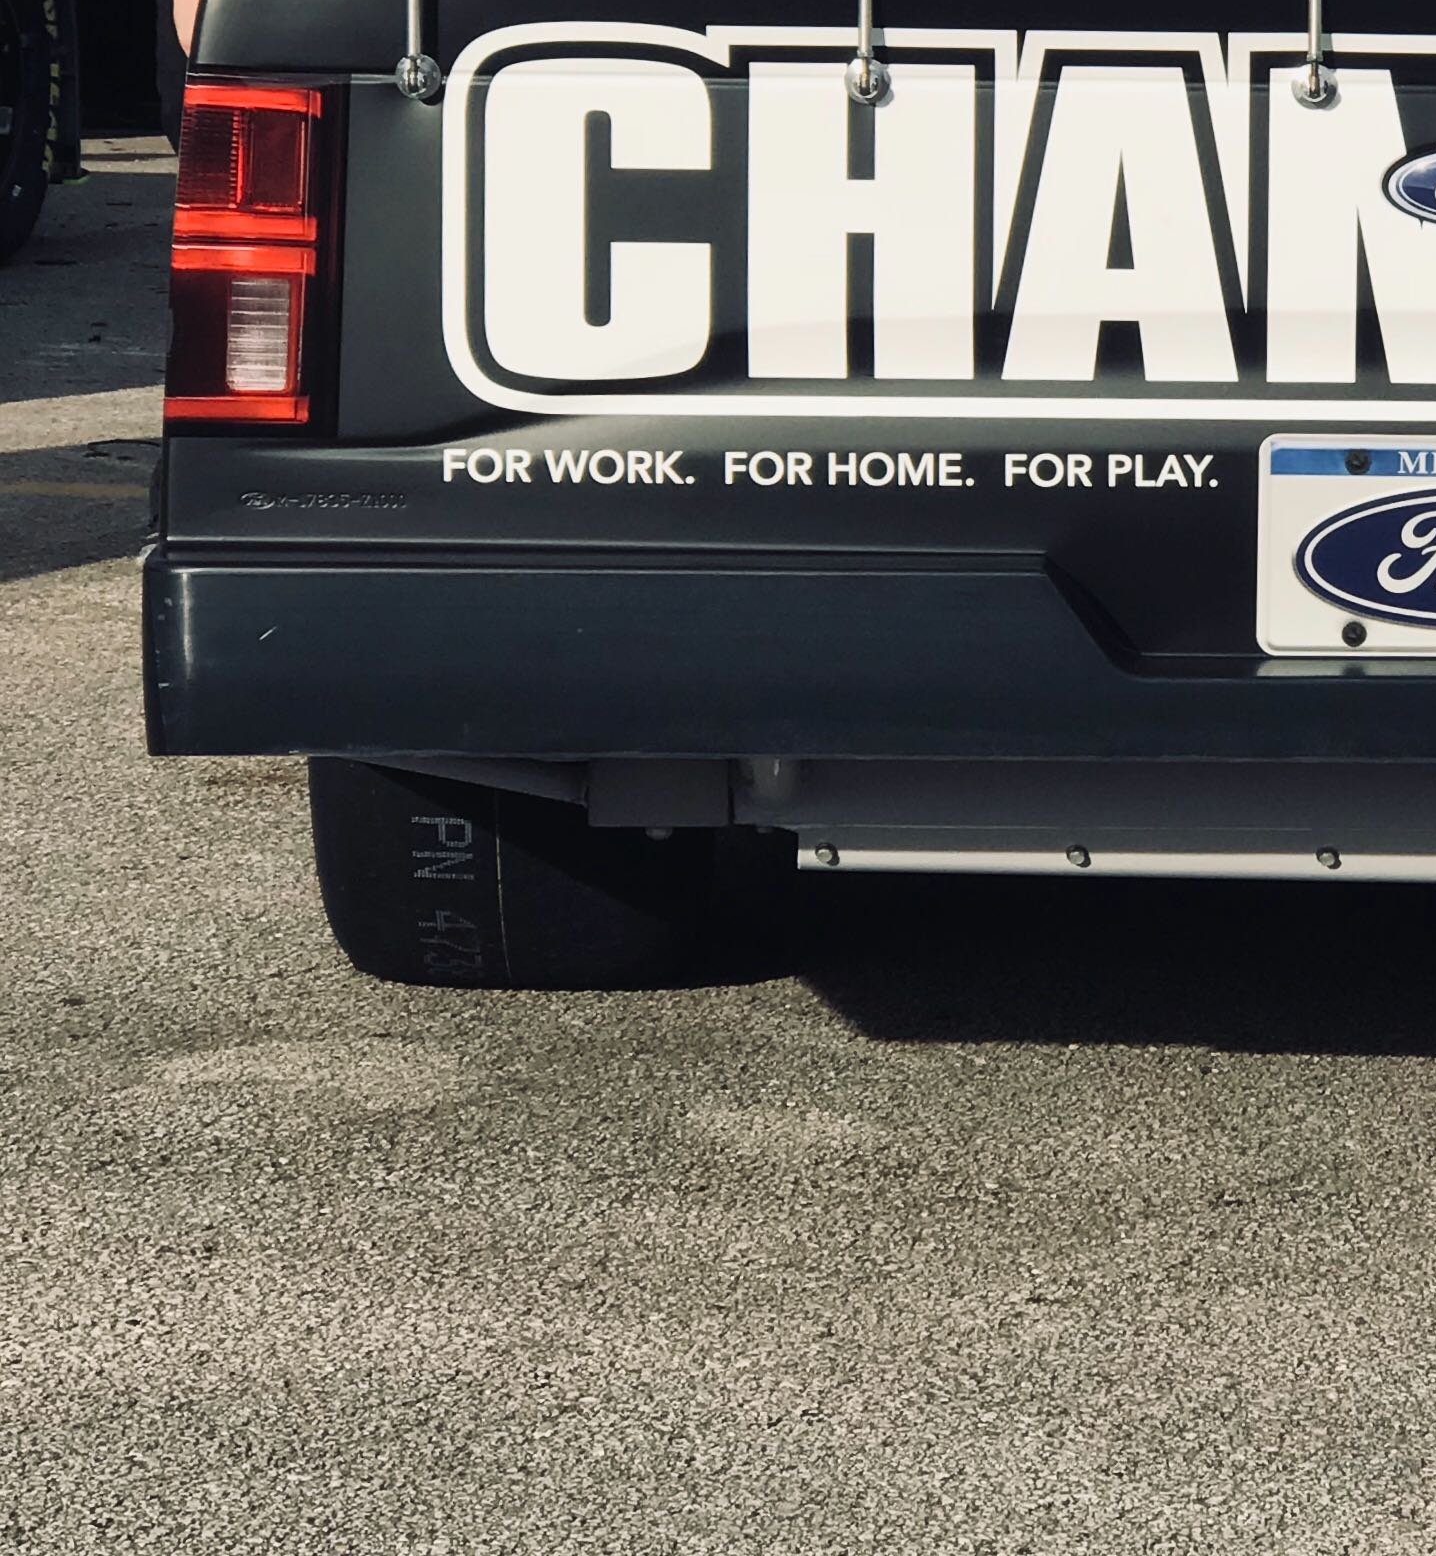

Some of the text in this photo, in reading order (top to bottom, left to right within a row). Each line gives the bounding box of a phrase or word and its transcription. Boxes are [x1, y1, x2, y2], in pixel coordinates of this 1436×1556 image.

[443, 449, 1219, 488] FOR WORK. FOR HOME. FOR PLAY.
